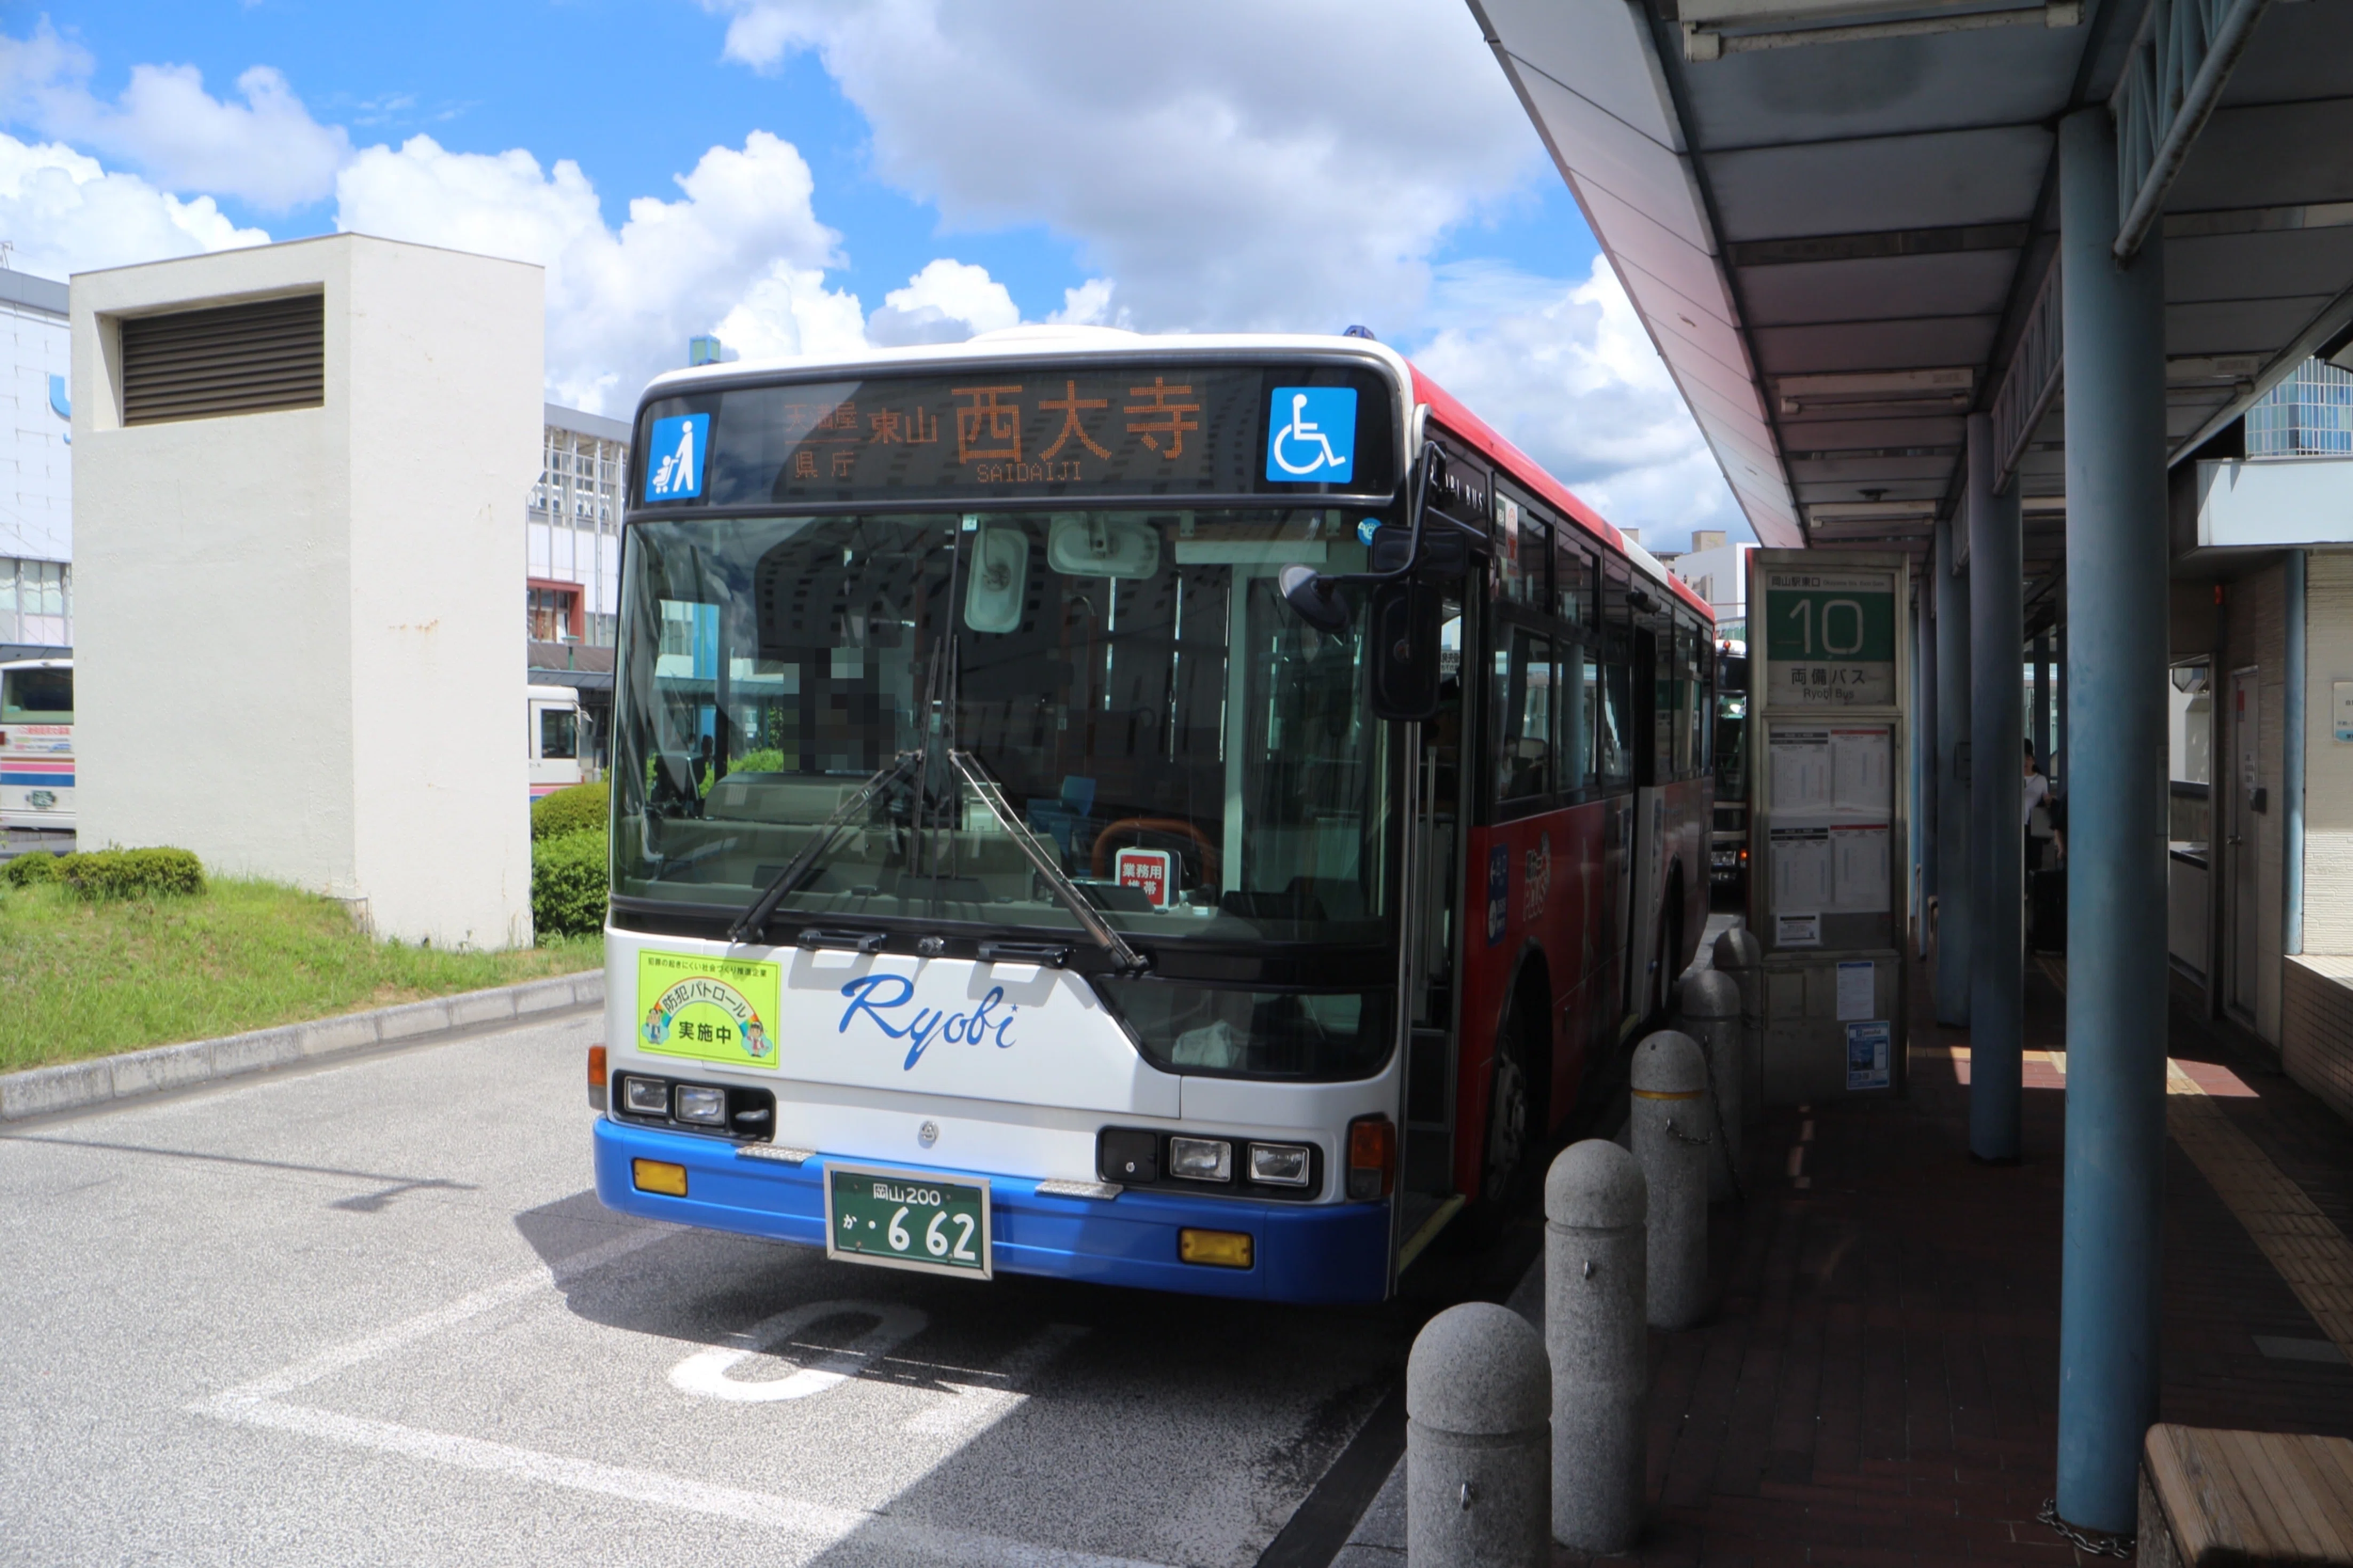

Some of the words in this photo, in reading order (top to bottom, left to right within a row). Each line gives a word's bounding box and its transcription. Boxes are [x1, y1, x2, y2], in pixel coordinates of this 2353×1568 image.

[784, 402, 858, 432] 天満屋
[867, 407, 937, 445] 東山
[951, 377, 1200, 464] 西大寺
[795, 450, 855, 478] 県庁
[977, 461, 1081, 482] SAIDAIJI
[1771, 575, 1821, 588] 岡山駅東口
[1789, 599, 1864, 655] 10
[1791, 668, 1866, 685] 両備バス
[1835, 688, 1855, 700] Bus
[1122, 862, 1162, 880] 業務用
[648, 956, 768, 978] 犯罪の起きにくい社会づくり推進企業
[662, 980, 746, 1019] 防犯パトロール
[678, 1021, 732, 1045] 実施中
[839, 973, 1017, 1071] Ryobi
